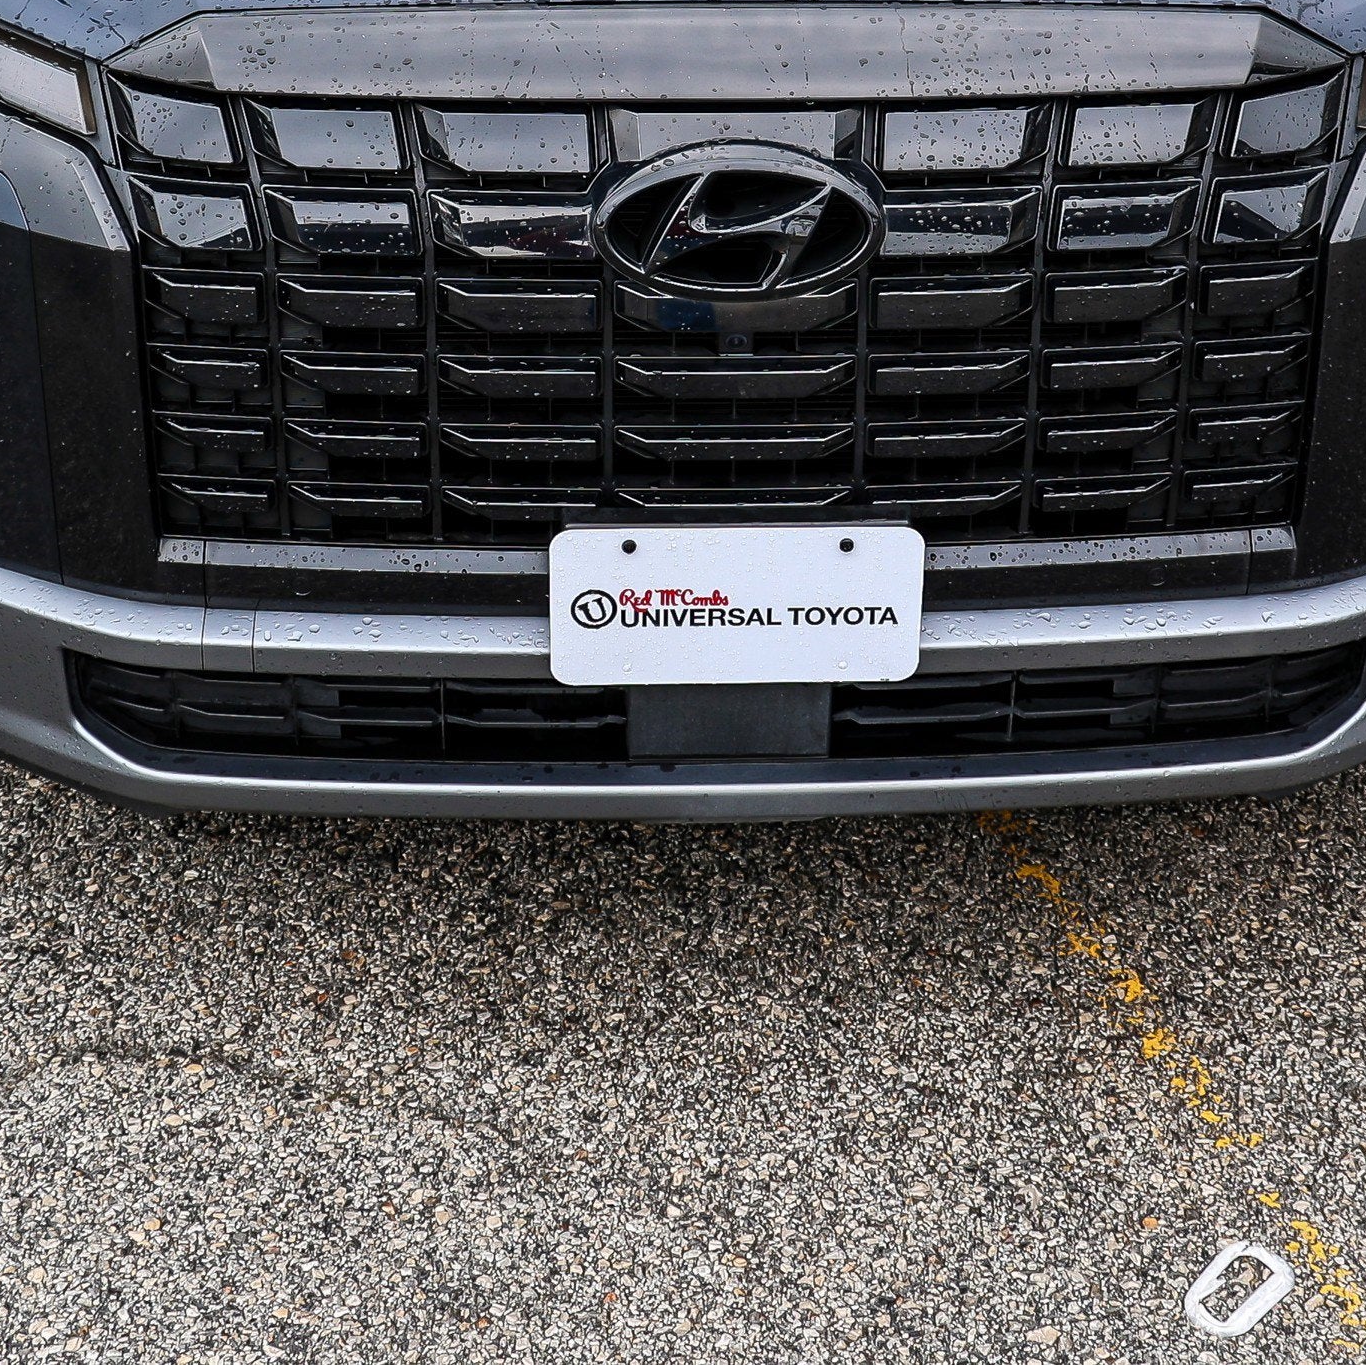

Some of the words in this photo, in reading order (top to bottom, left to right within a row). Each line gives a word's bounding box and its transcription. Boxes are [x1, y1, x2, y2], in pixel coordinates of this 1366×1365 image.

[619, 588, 653, 613] Red
[654, 588, 730, 607] McCombs
[620, 608, 782, 628] UNIVERSAL
[788, 605, 899, 627] TOYOTA
